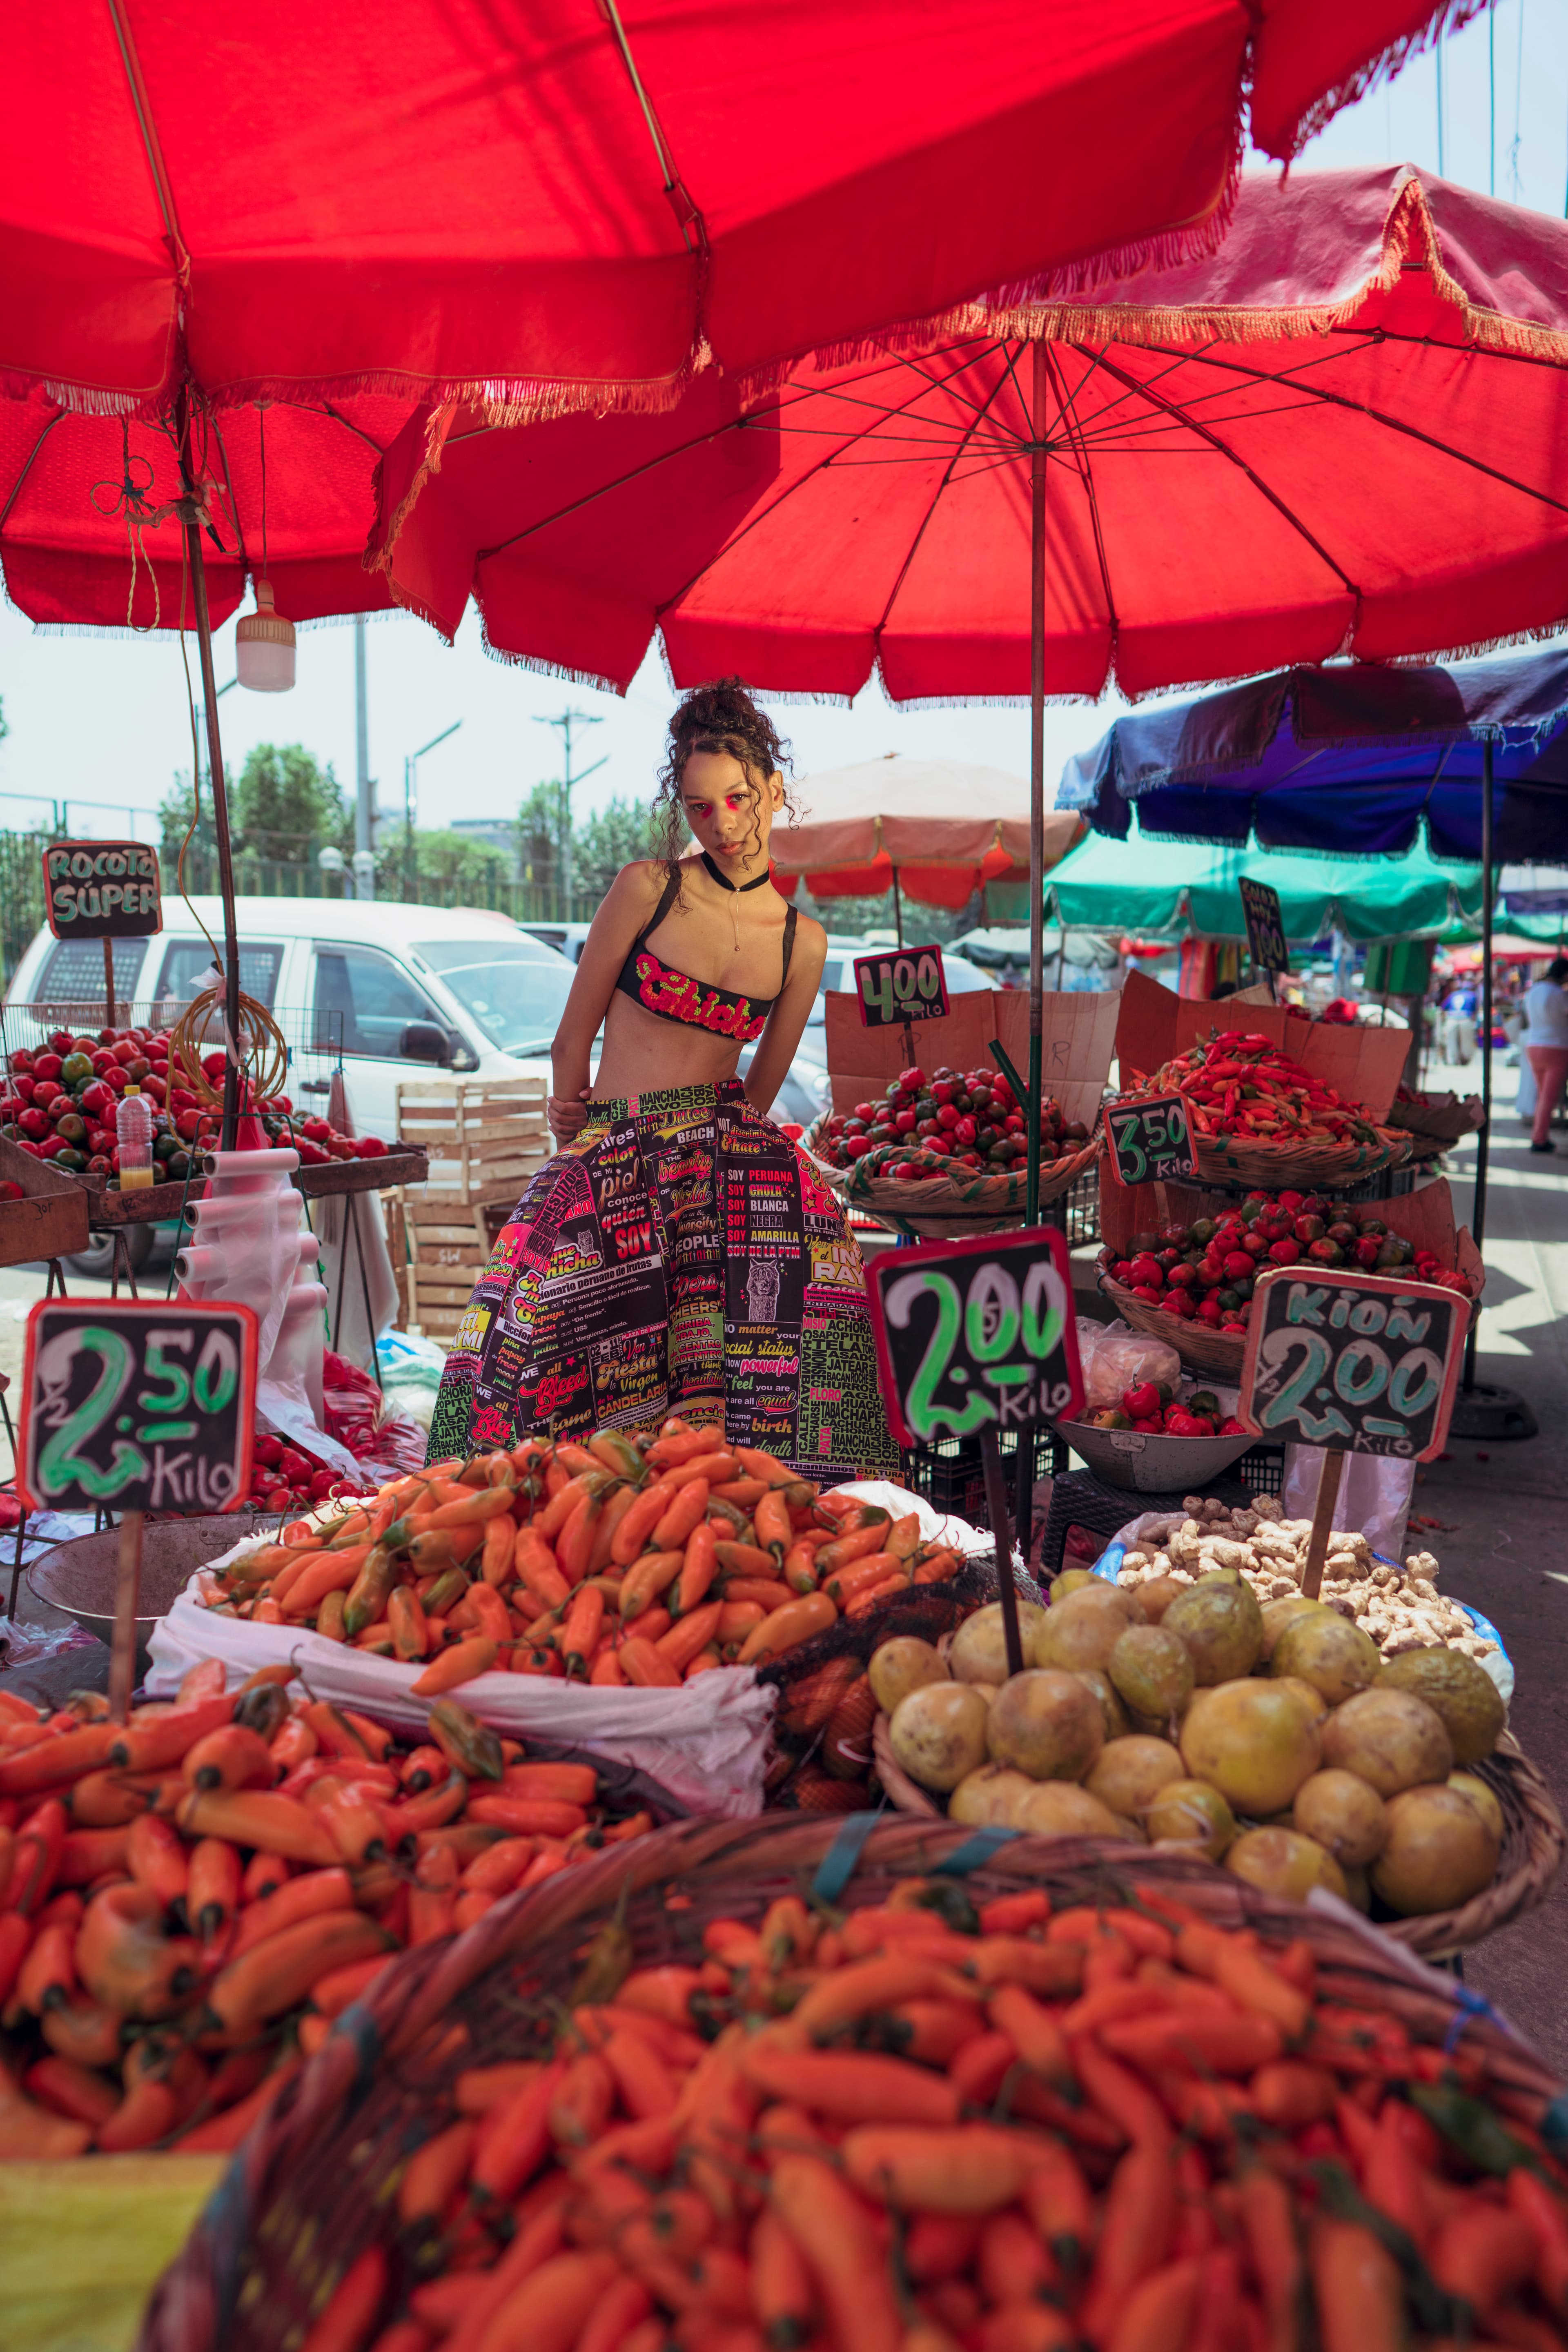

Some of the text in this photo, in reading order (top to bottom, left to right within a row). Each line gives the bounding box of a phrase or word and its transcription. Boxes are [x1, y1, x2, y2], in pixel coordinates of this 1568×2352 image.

[48, 849, 156, 880] ROCOTO
[53, 880, 159, 922] SÚPER
[639, 1089, 681, 1107] MANCHA
[639, 1101, 681, 1116] PAVO
[717, 1117, 730, 1132] NOT
[742, 1109, 765, 1127] love
[677, 1127, 714, 1144] BEACH
[598, 1145, 637, 1166] color
[658, 1149, 713, 1184] beauty
[728, 1169, 794, 1183] SOY PERUANA
[670, 1180, 713, 1210] World
[728, 1184, 783, 1197] SOY CHOLA
[540, 1173, 577, 1225] MESTIZO
[608, 1192, 648, 1207] conoce
[728, 1200, 789, 1212] SOY BLANCA
[602, 1203, 646, 1234] quién
[727, 1214, 783, 1227] SOY NEGRA
[804, 1214, 837, 1232] LUN
[615, 1221, 652, 1259] SOY
[727, 1229, 800, 1243] SOY AMARILLA
[804, 1234, 829, 1251] Ven
[675, 1234, 719, 1256] PEOPLE
[727, 1244, 800, 1259] SOY DE LA PTM
[522, 1249, 543, 1270] SOY
[550, 1245, 576, 1265] que
[820, 1251, 829, 1260] el
[577, 1260, 652, 1290] peruano de frutas
[563, 1293, 590, 1305] Persona
[591, 1288, 606, 1297] poco
[607, 1278, 639, 1291] afortunada.
[807, 1282, 857, 1294] fiesta
[578, 1299, 602, 1310] Sencillo
[628, 1284, 651, 1294] realizar.
[804, 1301, 852, 1310] ENTRADAS
[531, 1323, 557, 1338] fresa
[621, 1331, 640, 1340] PLAZA
[650, 1321, 668, 1332] ARMAS
[725, 1323, 735, 1333] NO
[738, 1325, 778, 1334] matter
[803, 1317, 826, 1330] MISIO
[532, 1333, 558, 1346] cocos
[533, 1343, 559, 1359] palta
[575, 1328, 609, 1343] Vergüenza,
[609, 1321, 628, 1331] miedo.
[675, 1328, 713, 1343] ABAJO,
[812, 1330, 840, 1340] SAPO
[501, 1337, 520, 1350] piña
[623, 1338, 646, 1361] Ven
[679, 1339, 722, 1353] CENTRO
[757, 1340, 796, 1356] status
[812, 1339, 862, 1353] TELA
[862, 1343, 877, 1355] TONO
[497, 1355, 519, 1372] fresa
[702, 1360, 722, 1370] think
[801, 1329, 812, 1395] CHAMBA
[811, 1349, 827, 1380] MONSE
[828, 1351, 877, 1363] ASADO
[495, 1367, 515, 1380] cocos
[547, 1361, 562, 1376] all
[596, 1354, 658, 1390] Fiesta
[740, 1355, 799, 1377] powerful
[827, 1359, 869, 1373] JATEAR
[492, 1376, 512, 1390] palta
[621, 1372, 658, 1392] Virgen
[683, 1370, 724, 1388] beautiful
[731, 1375, 754, 1390] feel
[826, 1371, 850, 1383] BACÁN
[851, 1372, 869, 1385] ROCHE
[869, 1364, 877, 1394] BAMBA
[518, 1365, 590, 1419] Bleed
[810, 1387, 841, 1401] FLORO
[811, 1380, 869, 1392] CHURRO
[476, 1385, 509, 1412] WE all
[598, 1381, 668, 1419] CANDELARIA
[821, 1401, 840, 1419] TABA
[840, 1408, 882, 1423] CHAPE
[527, 1416, 555, 1430] THE
[550, 1408, 592, 1435] same
[622, 1423, 635, 1432] DE
[741, 1422, 750, 1431] by
[751, 1417, 793, 1433] birth
[799, 1397, 810, 1452] CALETA
[809, 1400, 820, 1453] MECHARSE
[821, 1418, 882, 1430] CACHUELO
[831, 1427, 882, 1436] CHONGO
[755, 1439, 794, 1457] death
[819, 1427, 832, 1454] PATA
[831, 1433, 871, 1449] MANCHA
[831, 1446, 871, 1457] PAVO
[798, 1453, 899, 1469] PERUVIAN SLANG
[856, 1468, 904, 1478] CULTURA
